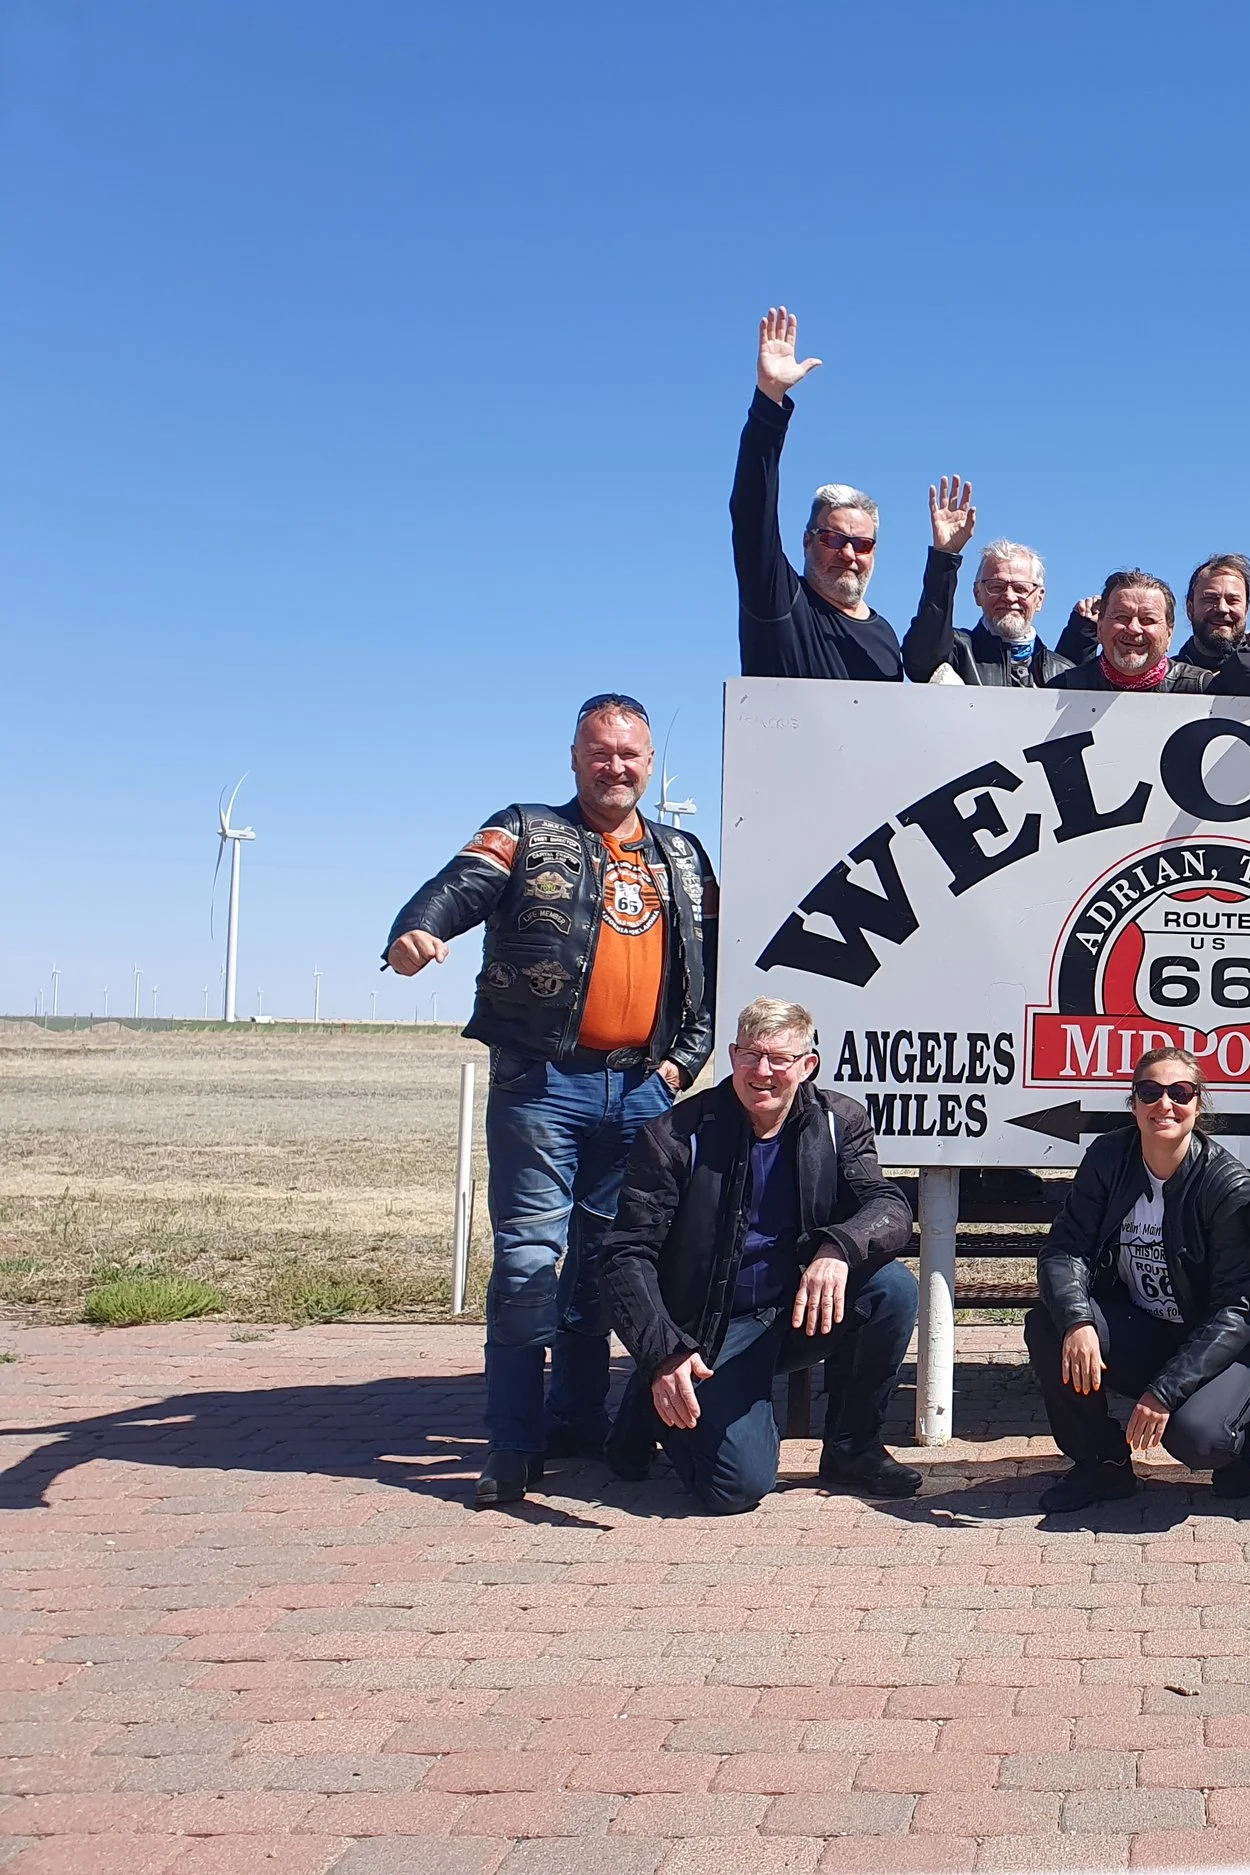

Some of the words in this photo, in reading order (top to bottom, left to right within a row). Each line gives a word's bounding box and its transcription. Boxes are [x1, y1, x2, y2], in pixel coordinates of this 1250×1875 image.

[1075, 850, 1219, 956] ADRIAN,
[523, 910, 538, 922] LIFE
[540, 910, 566, 925] MEMBER
[834, 1029, 1016, 1085] ANGELES
[865, 1093, 988, 1138] MILES
[1122, 1221, 1142, 1235] velin'
[1142, 1222, 1162, 1237] Main
[1135, 1246, 1166, 1261] HISTOR
[1135, 1261, 1168, 1276] ROUT
[1141, 1273, 1173, 1299] 66
